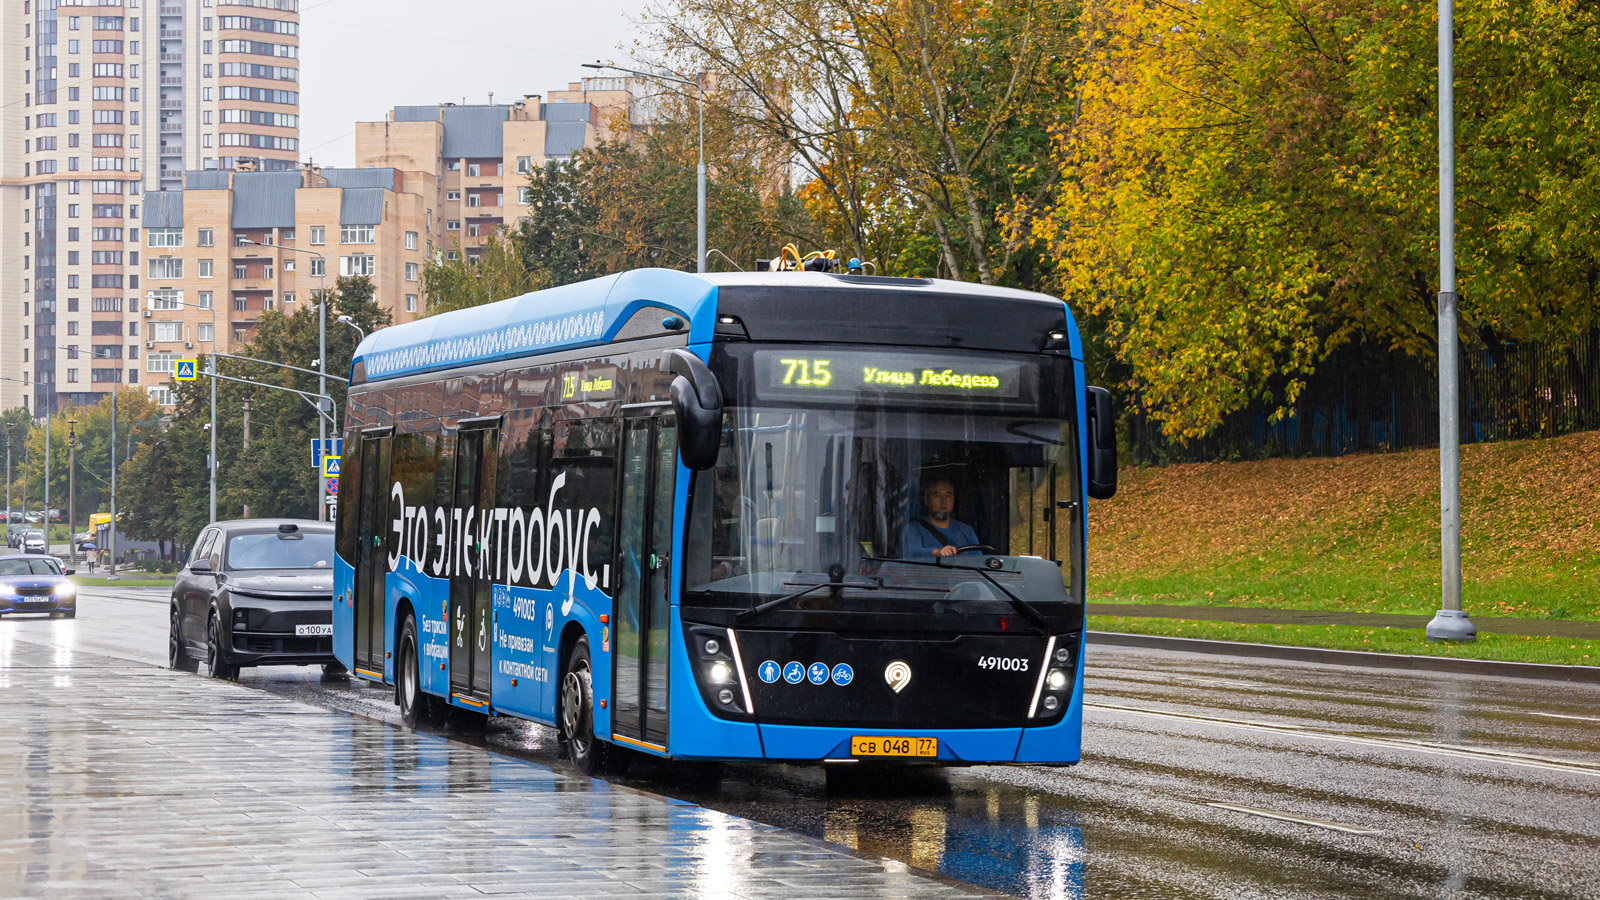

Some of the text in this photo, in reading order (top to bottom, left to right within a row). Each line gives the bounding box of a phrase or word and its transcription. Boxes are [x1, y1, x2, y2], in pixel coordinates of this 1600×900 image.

[780, 358, 999, 388] 715 Улица Лебедева
[563, 376, 575, 398] 715
[388, 470, 610, 617] Это электробус.
[513, 596, 535, 621] 491003
[499, 629, 507, 648] Не
[508, 634, 534, 654] привязан
[499, 660, 548, 683] к контактной сети
[978, 656, 1029, 672] 491003
[883, 739, 909, 753] 048
[919, 740, 932, 750] 77
